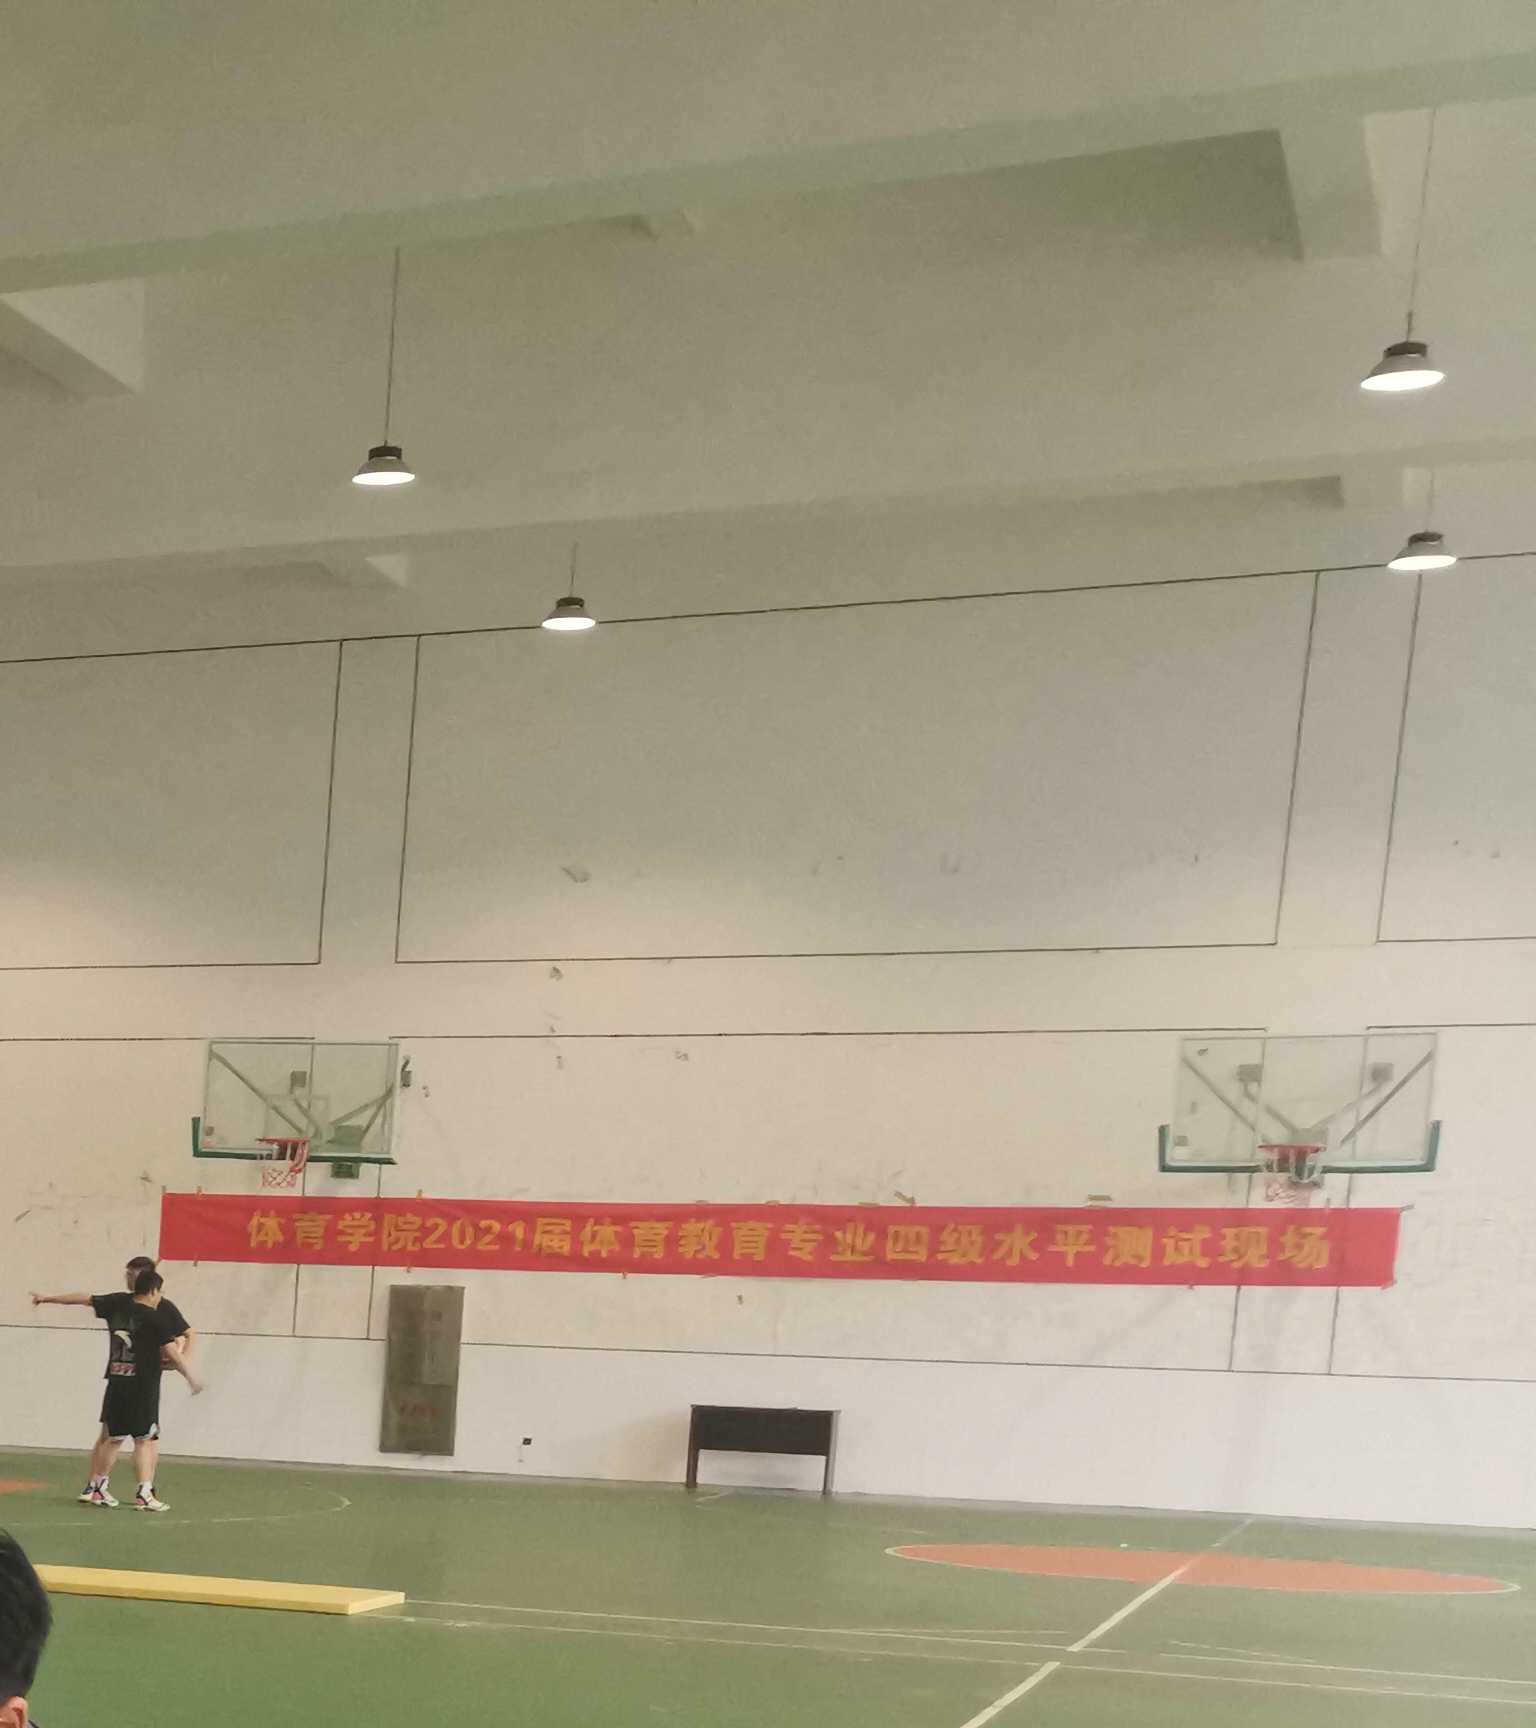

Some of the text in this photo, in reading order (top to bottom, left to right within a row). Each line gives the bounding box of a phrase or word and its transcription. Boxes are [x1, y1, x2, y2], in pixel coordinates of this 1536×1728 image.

[246, 1209, 1330, 1269] 体育学院2021届体育教育专业四级水平测试现场
